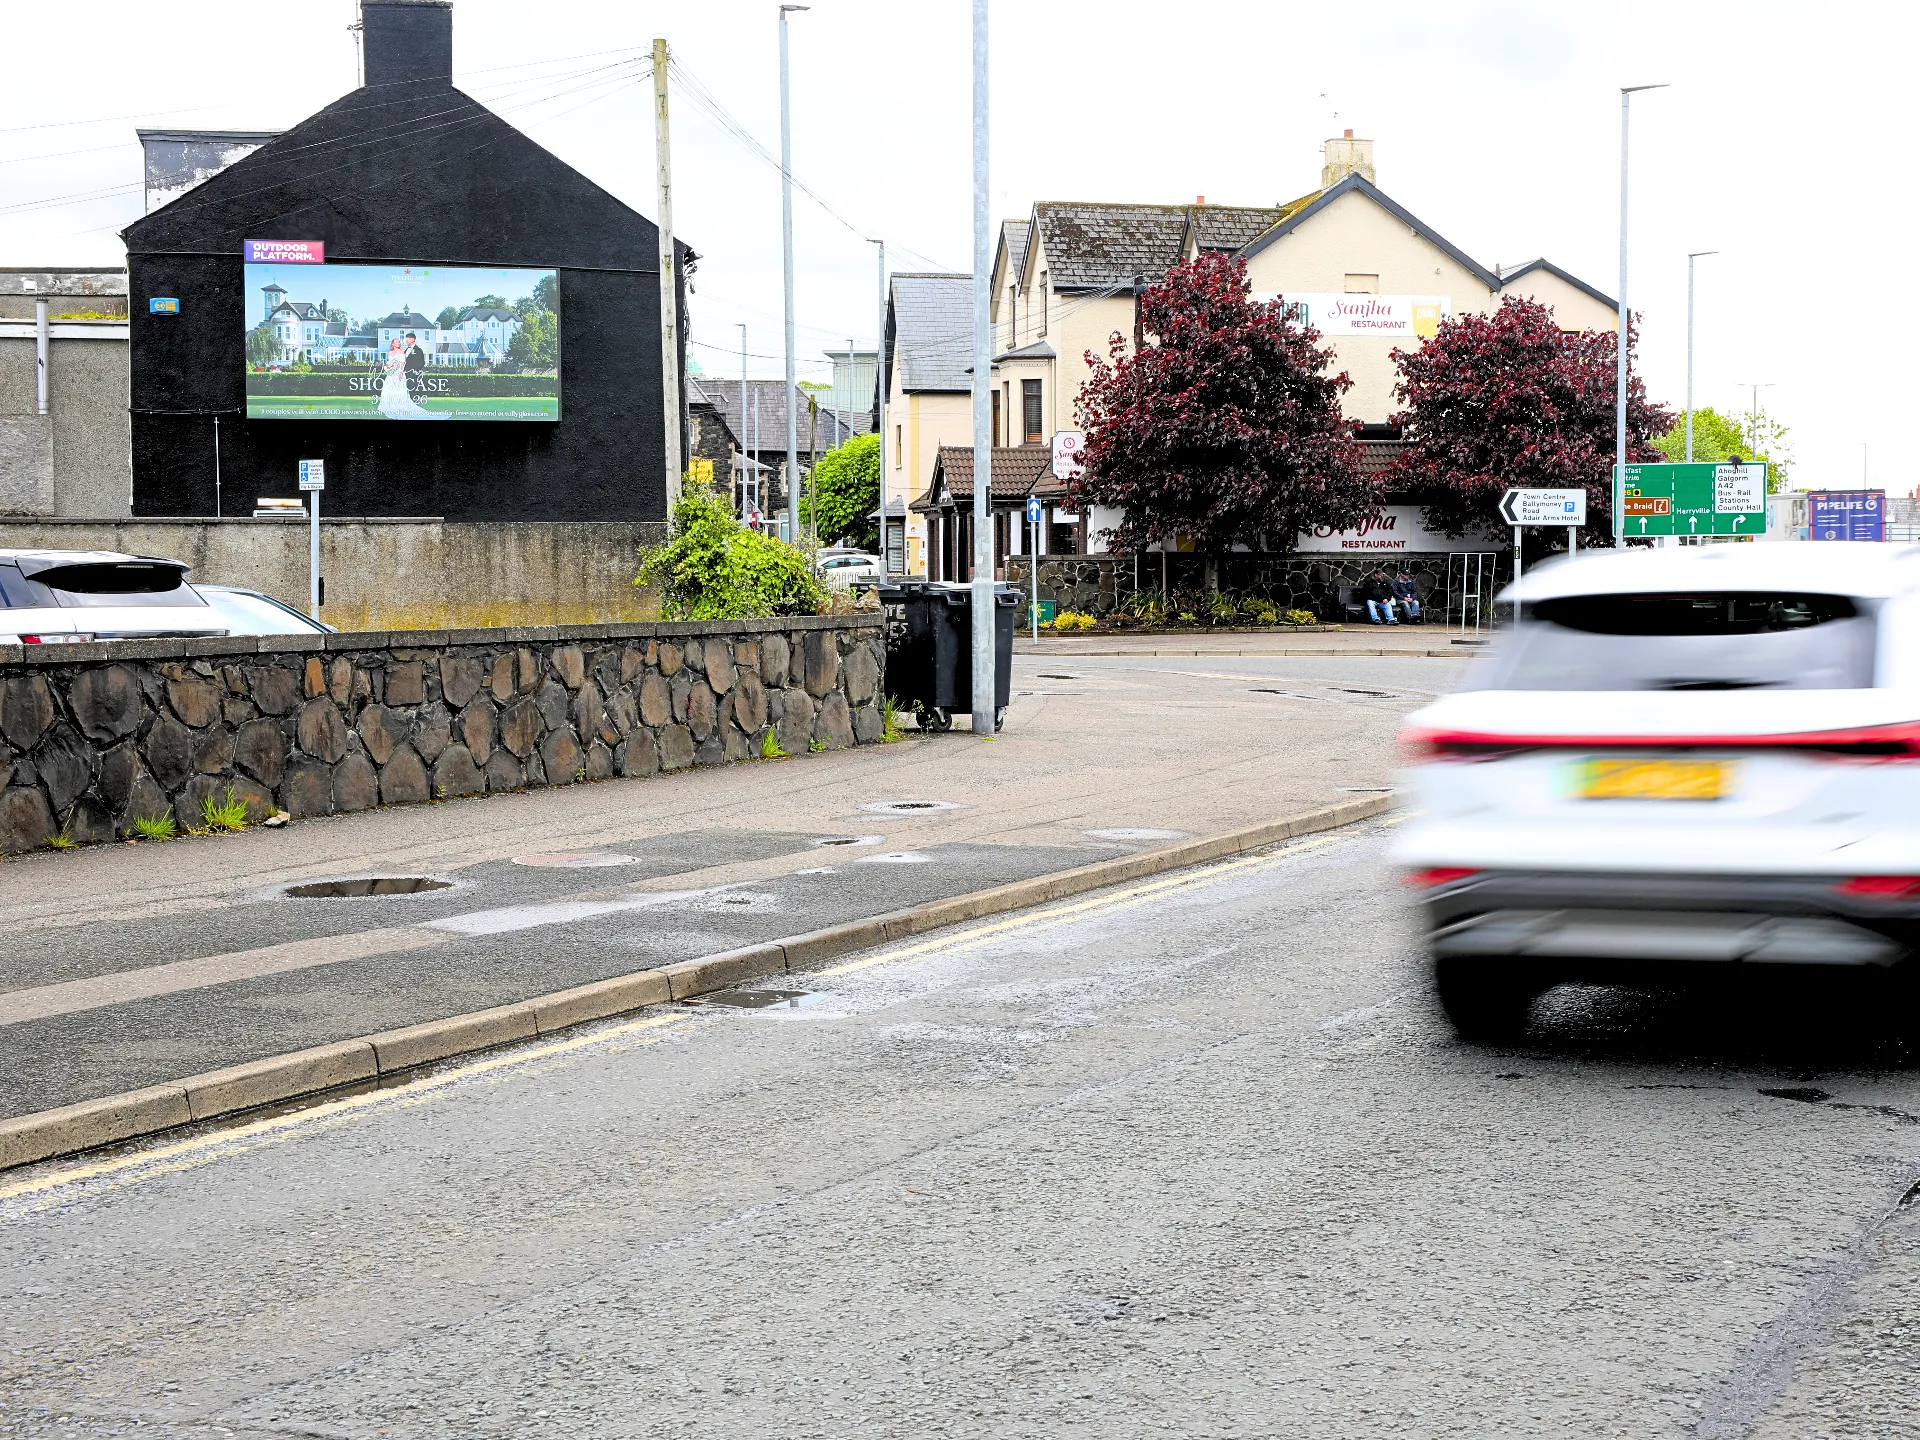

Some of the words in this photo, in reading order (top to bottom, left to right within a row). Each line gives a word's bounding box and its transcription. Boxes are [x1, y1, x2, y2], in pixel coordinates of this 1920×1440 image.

[253, 243, 308, 252] OUTDOOR
[253, 252, 315, 260] PLATFORM.
[1328, 300, 1392, 318] Sanjha
[1351, 320, 1406, 329] RESTAURANT
[349, 377, 449, 392] SHOWCASE
[1566, 503, 1573, 511] P
[1817, 501, 1863, 510] PIPELIFE
